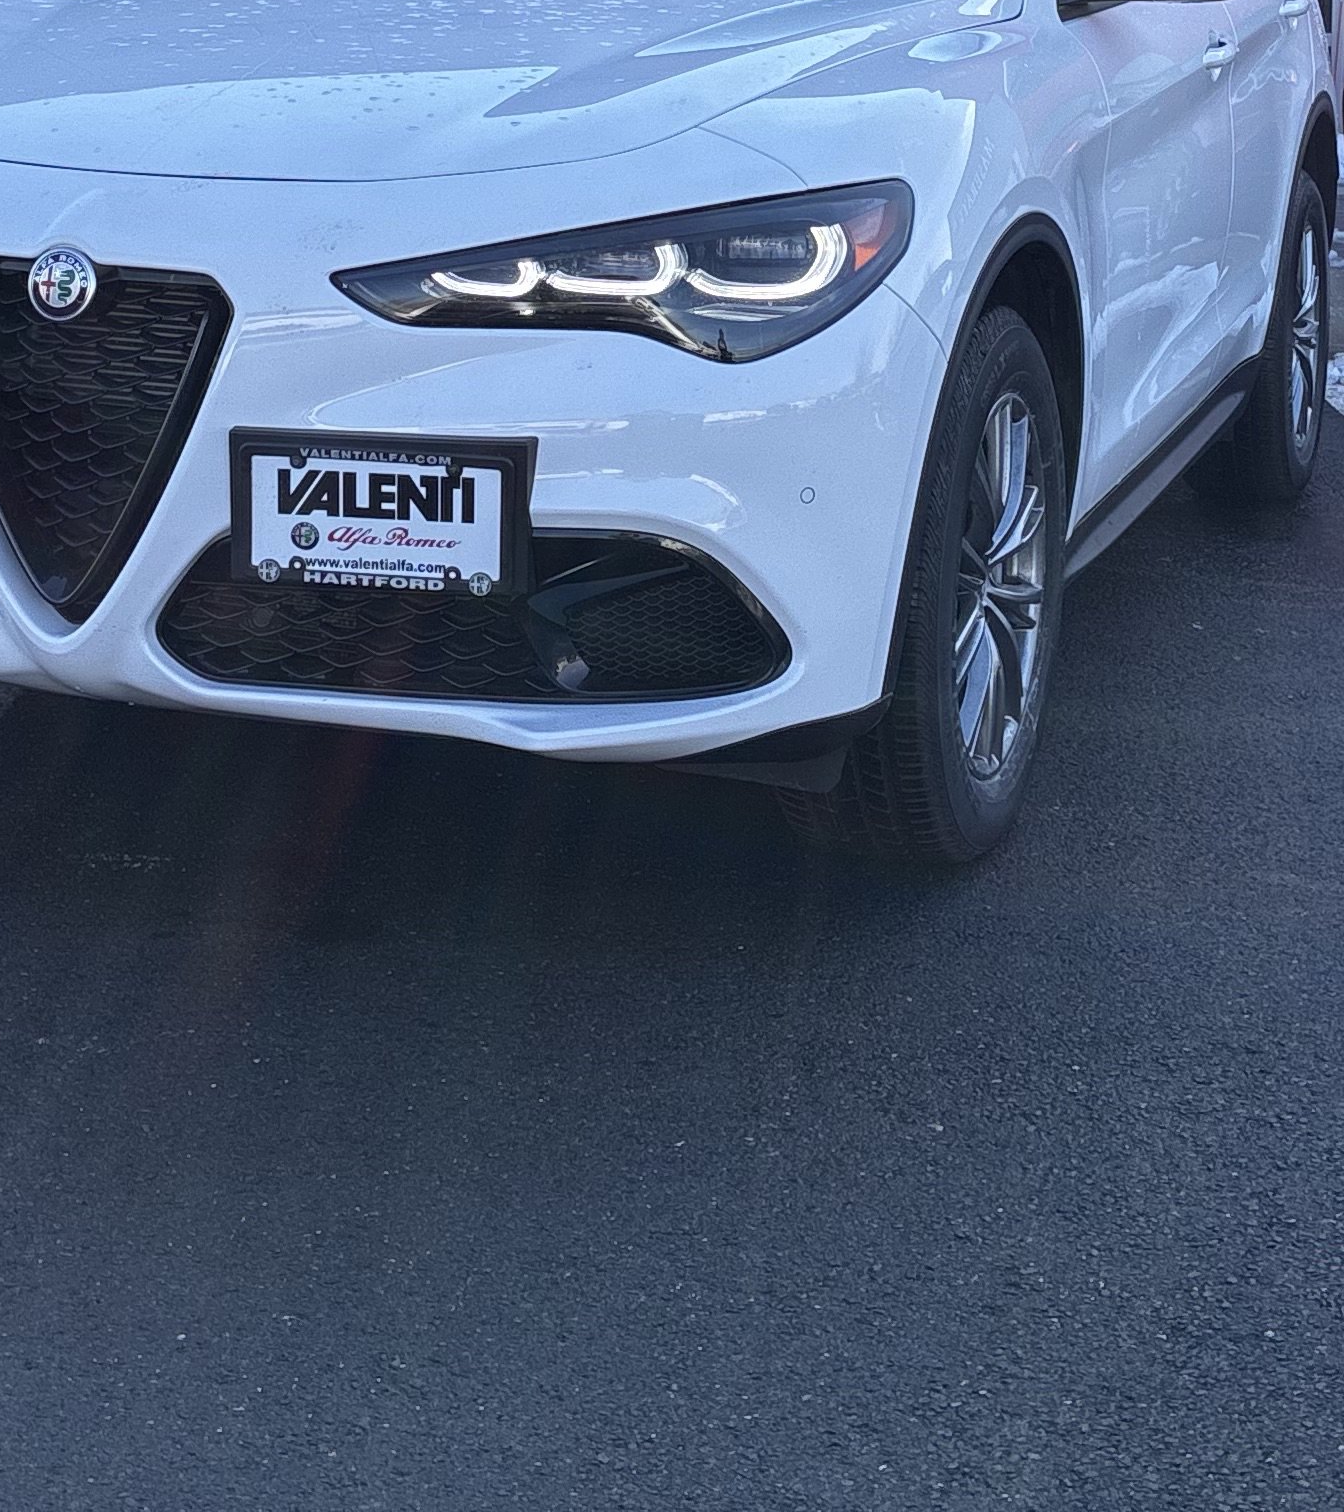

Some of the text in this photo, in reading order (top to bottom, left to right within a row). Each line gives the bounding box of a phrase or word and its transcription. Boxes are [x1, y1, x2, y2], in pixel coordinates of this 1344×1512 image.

[33, 254, 88, 288] ALFA ROMEO
[300, 447, 452, 465] VALENTIALFA.COM
[277, 468, 475, 524] VALENTI
[327, 526, 382, 551] Alfa
[383, 526, 461, 549] Romeo
[305, 557, 446, 574] www.valentialfa.com
[303, 570, 445, 591] HARTFORD
